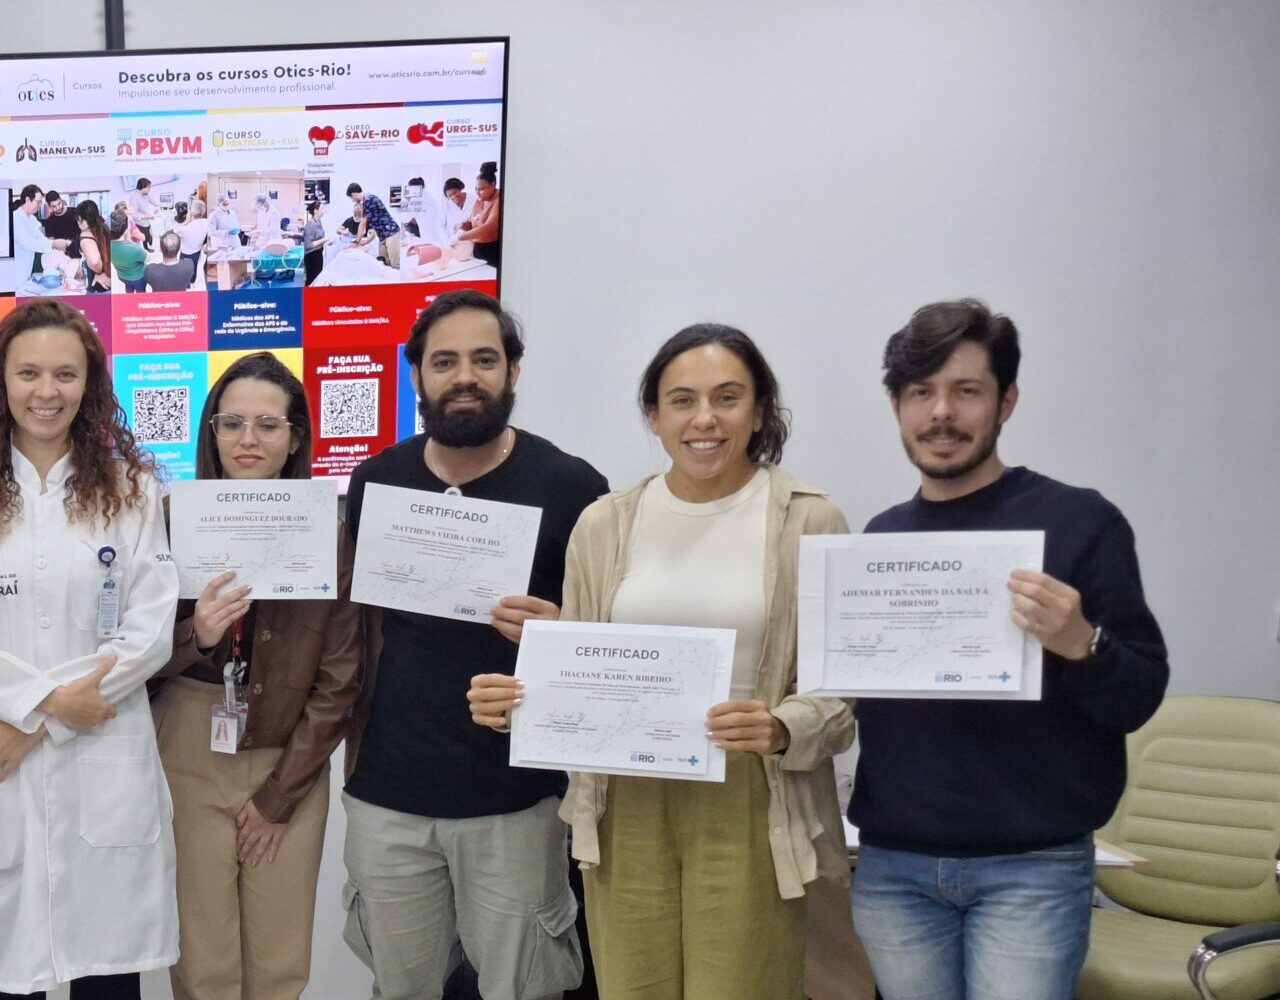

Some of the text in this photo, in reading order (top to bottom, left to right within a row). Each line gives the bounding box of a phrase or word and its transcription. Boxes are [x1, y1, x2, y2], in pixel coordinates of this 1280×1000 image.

[119, 63, 351, 84] Descubra os cursos Otics-Rio!
[73, 82, 102, 90] Cursos
[118, 82, 336, 99] Impulsione seu desenvolvimento profissional.
[18, 88, 55, 102] otics
[345, 129, 400, 140] SAVE-RIO
[446, 124, 498, 134] URGE-SUS
[226, 131, 261, 140] CURSO
[39, 146, 106, 155] MANEVA-SUS
[136, 136, 202, 155] PBVM
[328, 355, 370, 366] FAÇA SUA
[139, 362, 180, 372] FAÇA SUA
[317, 363, 384, 374] PRÉ-INSCRIÇÃO
[328, 444, 368, 454] Atenção!
[216, 492, 291, 502] CERTIFICADO
[410, 503, 489, 524] CERTIFICADO
[392, 524, 500, 547] MATTHEWS VIEIRA COELHO
[866, 560, 963, 573] CERTIFICADO
[883, 588, 939, 596] FERNANDES
[461, 608, 476, 616] RIO
[575, 646, 660, 660] CERTIFICADO
[604, 672, 634, 682] KAREN
[635, 674, 672, 684] RIBEIRO
[943, 674, 962, 683] RIO
[638, 754, 656, 763] RIO
